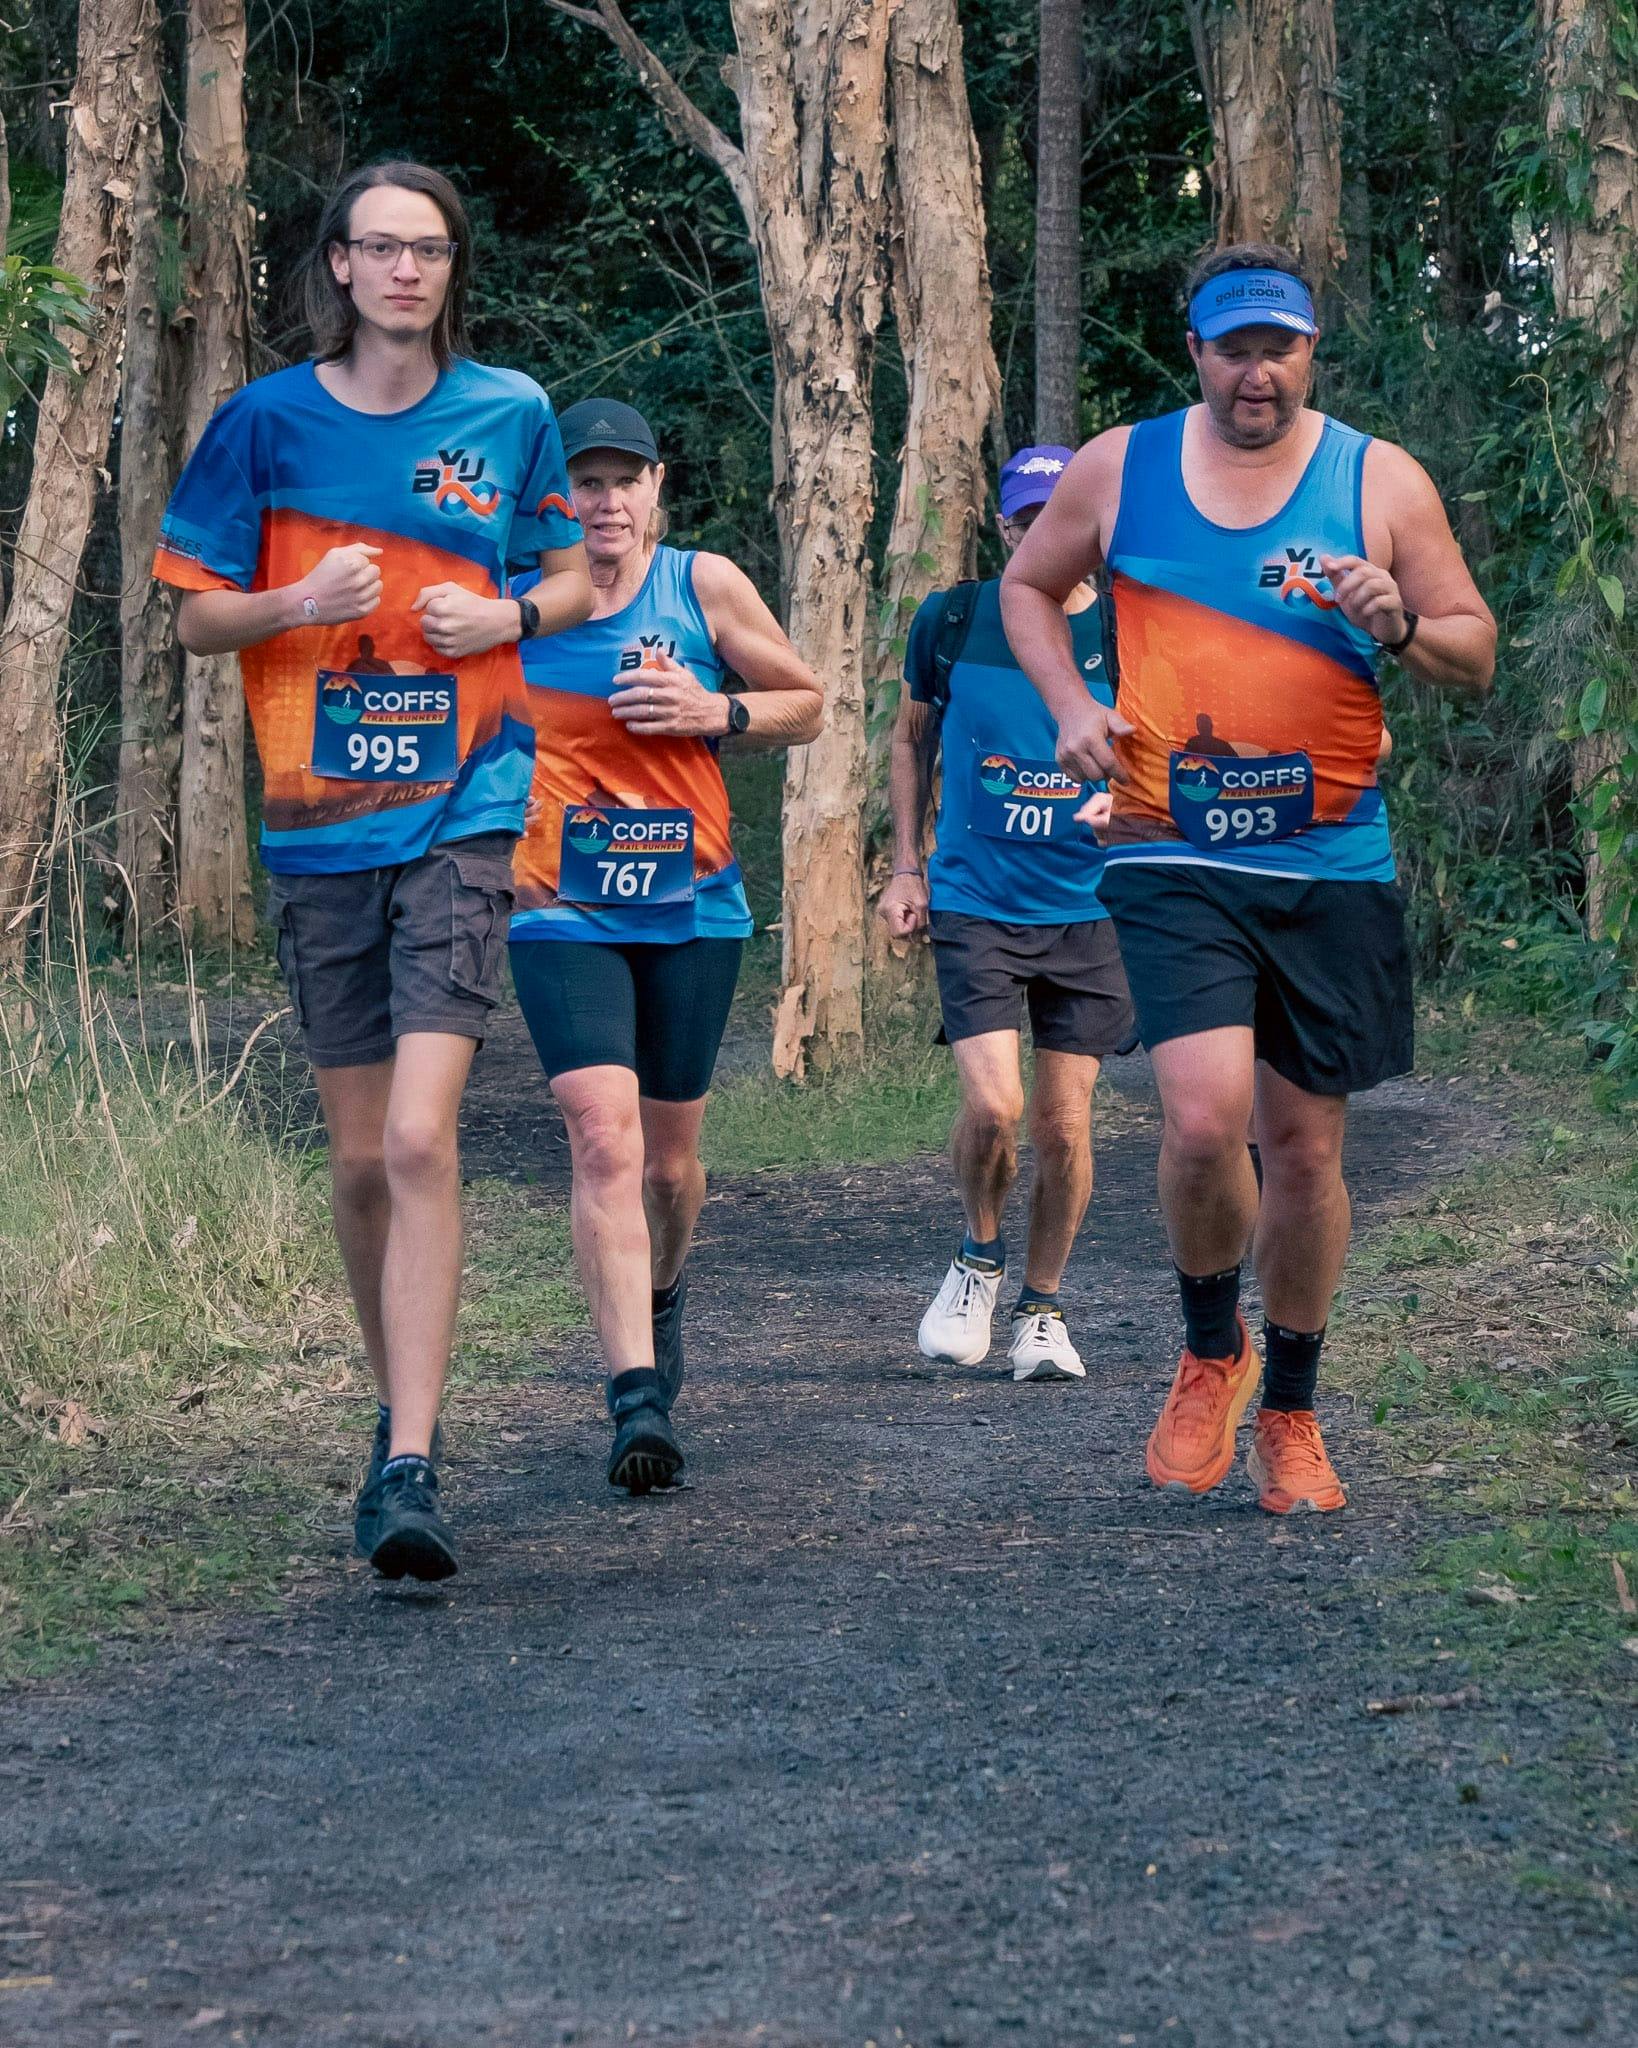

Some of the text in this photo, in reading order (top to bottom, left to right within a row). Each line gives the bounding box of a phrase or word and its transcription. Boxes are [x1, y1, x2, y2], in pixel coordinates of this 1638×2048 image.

[1216, 284, 1287, 306] gold coast
[363, 690, 452, 712] COFFS
[366, 713, 444, 723] TRAIL RUNNERS
[347, 732, 420, 774] 995
[1222, 766, 1307, 788] COFFS
[375, 783, 440, 806] FINISH
[1018, 787, 1078, 797] TRAIL RUNNERS
[1225, 786, 1301, 798] TRAIL RUNNERS
[1003, 801, 1054, 837] 701
[1205, 806, 1278, 842] 993
[612, 822, 689, 841] COFFS
[642, 842, 683, 850] RUNNERS
[597, 861, 658, 897] 767
